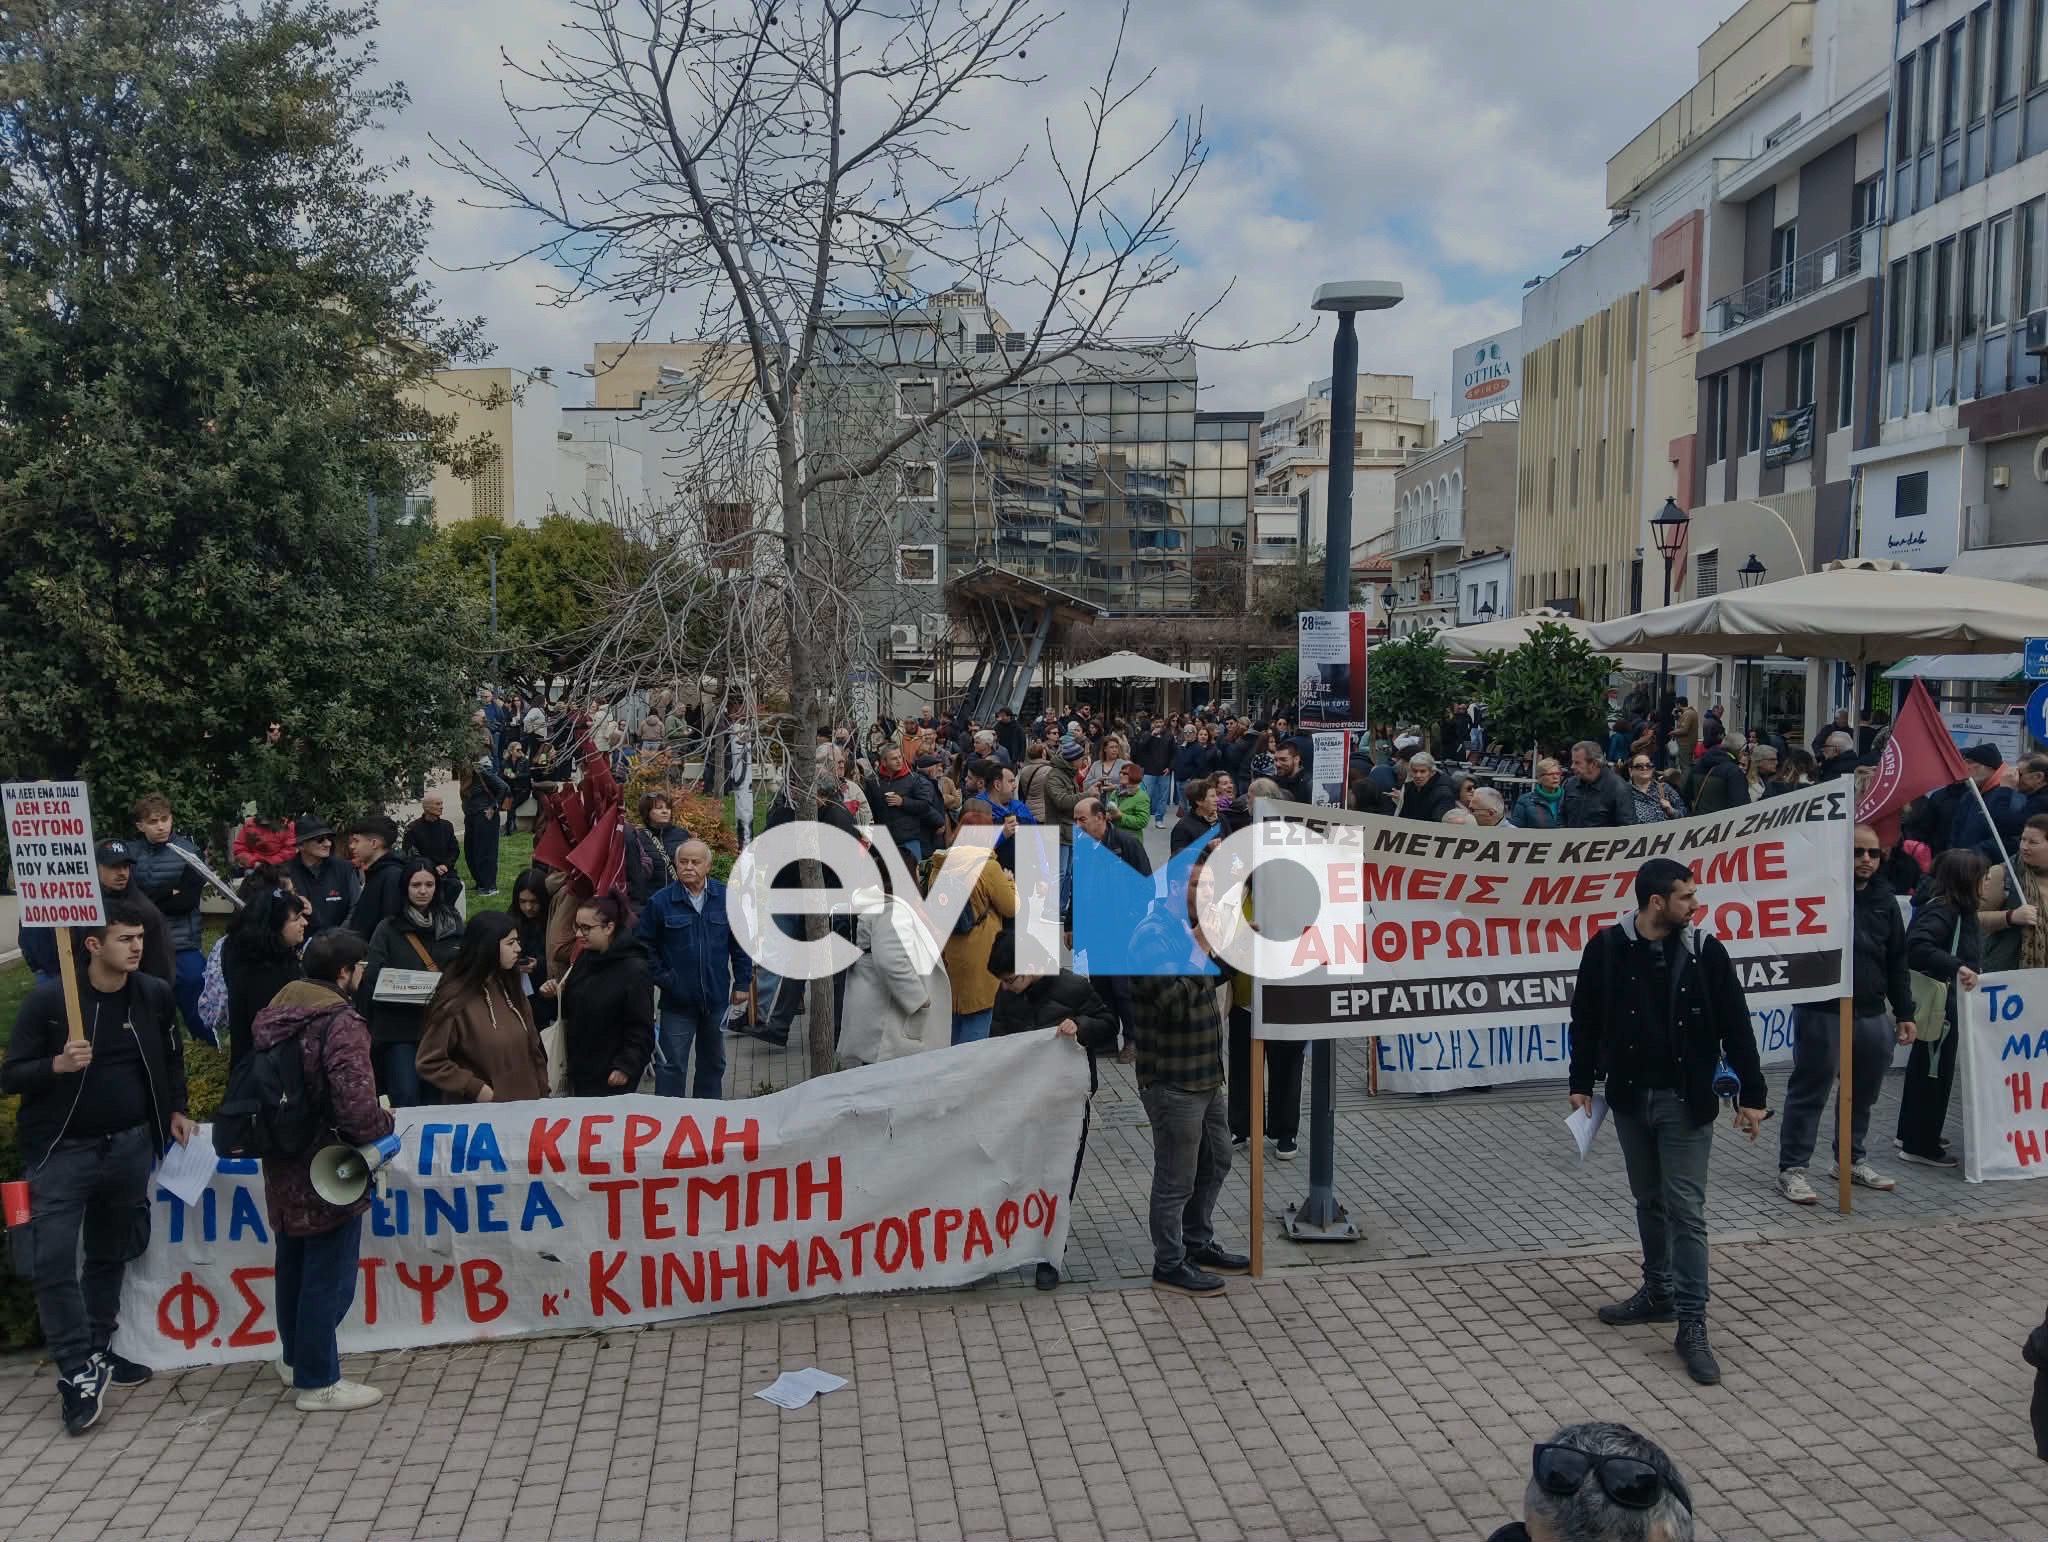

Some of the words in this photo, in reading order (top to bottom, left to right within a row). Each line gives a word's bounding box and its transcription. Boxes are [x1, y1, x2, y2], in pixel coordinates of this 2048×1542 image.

[1302, 616, 1314, 630] 28
[6, 788, 17, 800] ΝΑ
[38, 787, 54, 799] ΕΝΑ
[57, 786, 79, 798] ΠΑΙΔΙ
[15, 802, 40, 815] ΔΕΝ
[43, 801, 70, 815] ΕΧΩ
[12, 819, 84, 836] ΟΞΥΓΟΝΟ
[1262, 815, 1365, 847] ΕΣΕΙΣ
[1374, 829, 1552, 864] ΜΕΤΡΑΤΕ
[1558, 832, 1675, 864] ΚΕΡΔΗ
[1679, 820, 1735, 851] ΚΑΙ
[1735, 791, 1847, 839] ΖΗΜΙΕΣ
[16, 843, 47, 857] ΑΥΤΟ
[51, 842, 87, 856] ΕΙΝΑΙ
[17, 862, 42, 876] ΠΟΥ
[47, 861, 89, 876] ΚΑΝΕΙ
[1327, 862, 1509, 905] ΕΜΕΙΣ
[1522, 841, 1788, 905] ΜΕΤΑΜΕ
[20, 882, 37, 899] ΤΟ
[40, 881, 94, 899] ΚΡΑΤΟΣ
[25, 905, 98, 922] ΔΟΛΟΦΟΝΟ
[1290, 911, 1632, 966] ΑΝΘΡΩΠΙΝΕ
[1330, 981, 1488, 1017] ΕΡΓΑΤΙΚΟ
[418, 1122, 508, 1175] ΓΙΑ
[528, 1114, 759, 1175] ΚΕΡΔΗ
[589, 1156, 843, 1240] ΤΕΜΠΗ
[589, 1187, 1058, 1317] ΚΙΝΗΜΑΤΟΓΡΑΦΟΥ
